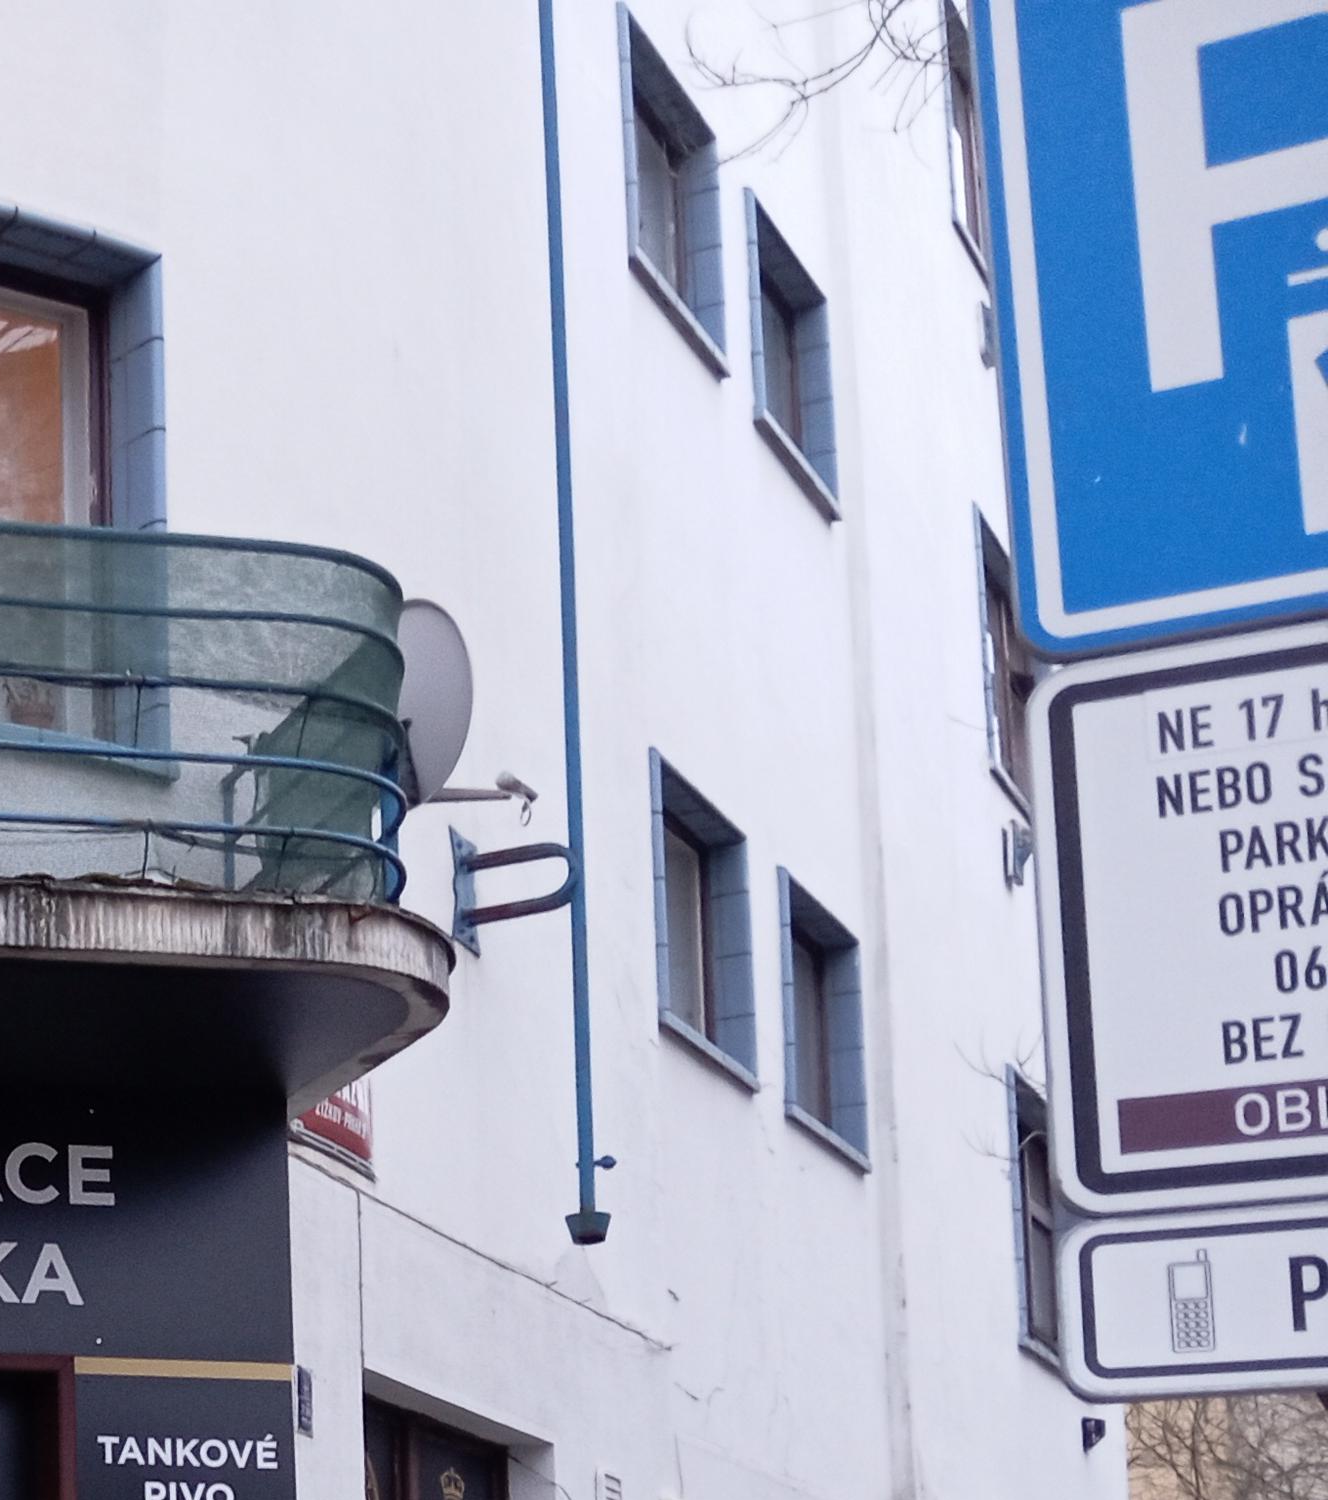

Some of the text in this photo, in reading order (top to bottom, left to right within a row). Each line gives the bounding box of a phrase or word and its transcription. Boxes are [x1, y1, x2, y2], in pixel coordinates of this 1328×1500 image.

[1157, 704, 1214, 754] NE
[1239, 693, 1284, 741] 17
[1156, 761, 1272, 818] NEBO
[1222, 1013, 1304, 1065] BEZ
[97, 1434, 279, 1470] TANKOVÉ
